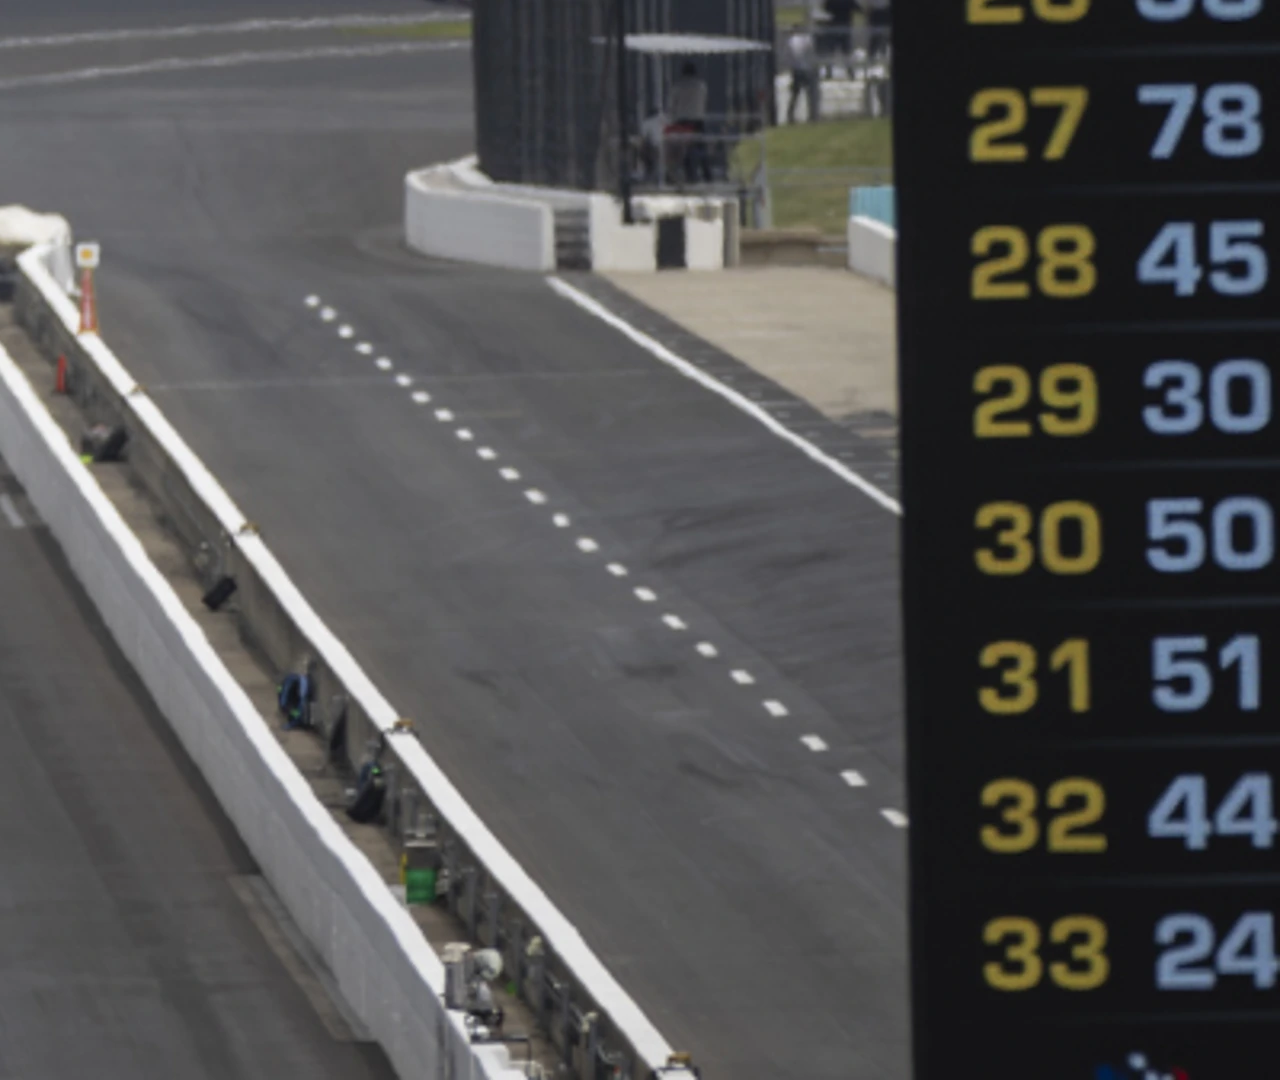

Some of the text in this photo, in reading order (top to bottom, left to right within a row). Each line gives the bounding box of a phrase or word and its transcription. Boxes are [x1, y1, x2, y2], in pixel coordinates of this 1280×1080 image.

[972, 84, 1261, 160] 27 78
[973, 221, 1267, 297] 28 45
[976, 360, 1270, 436] 29 30
[977, 498, 1273, 572] 30 50
[981, 636, 1258, 712] 31 51
[983, 775, 1277, 850] 32 44
[986, 914, 1280, 988] 33 24
